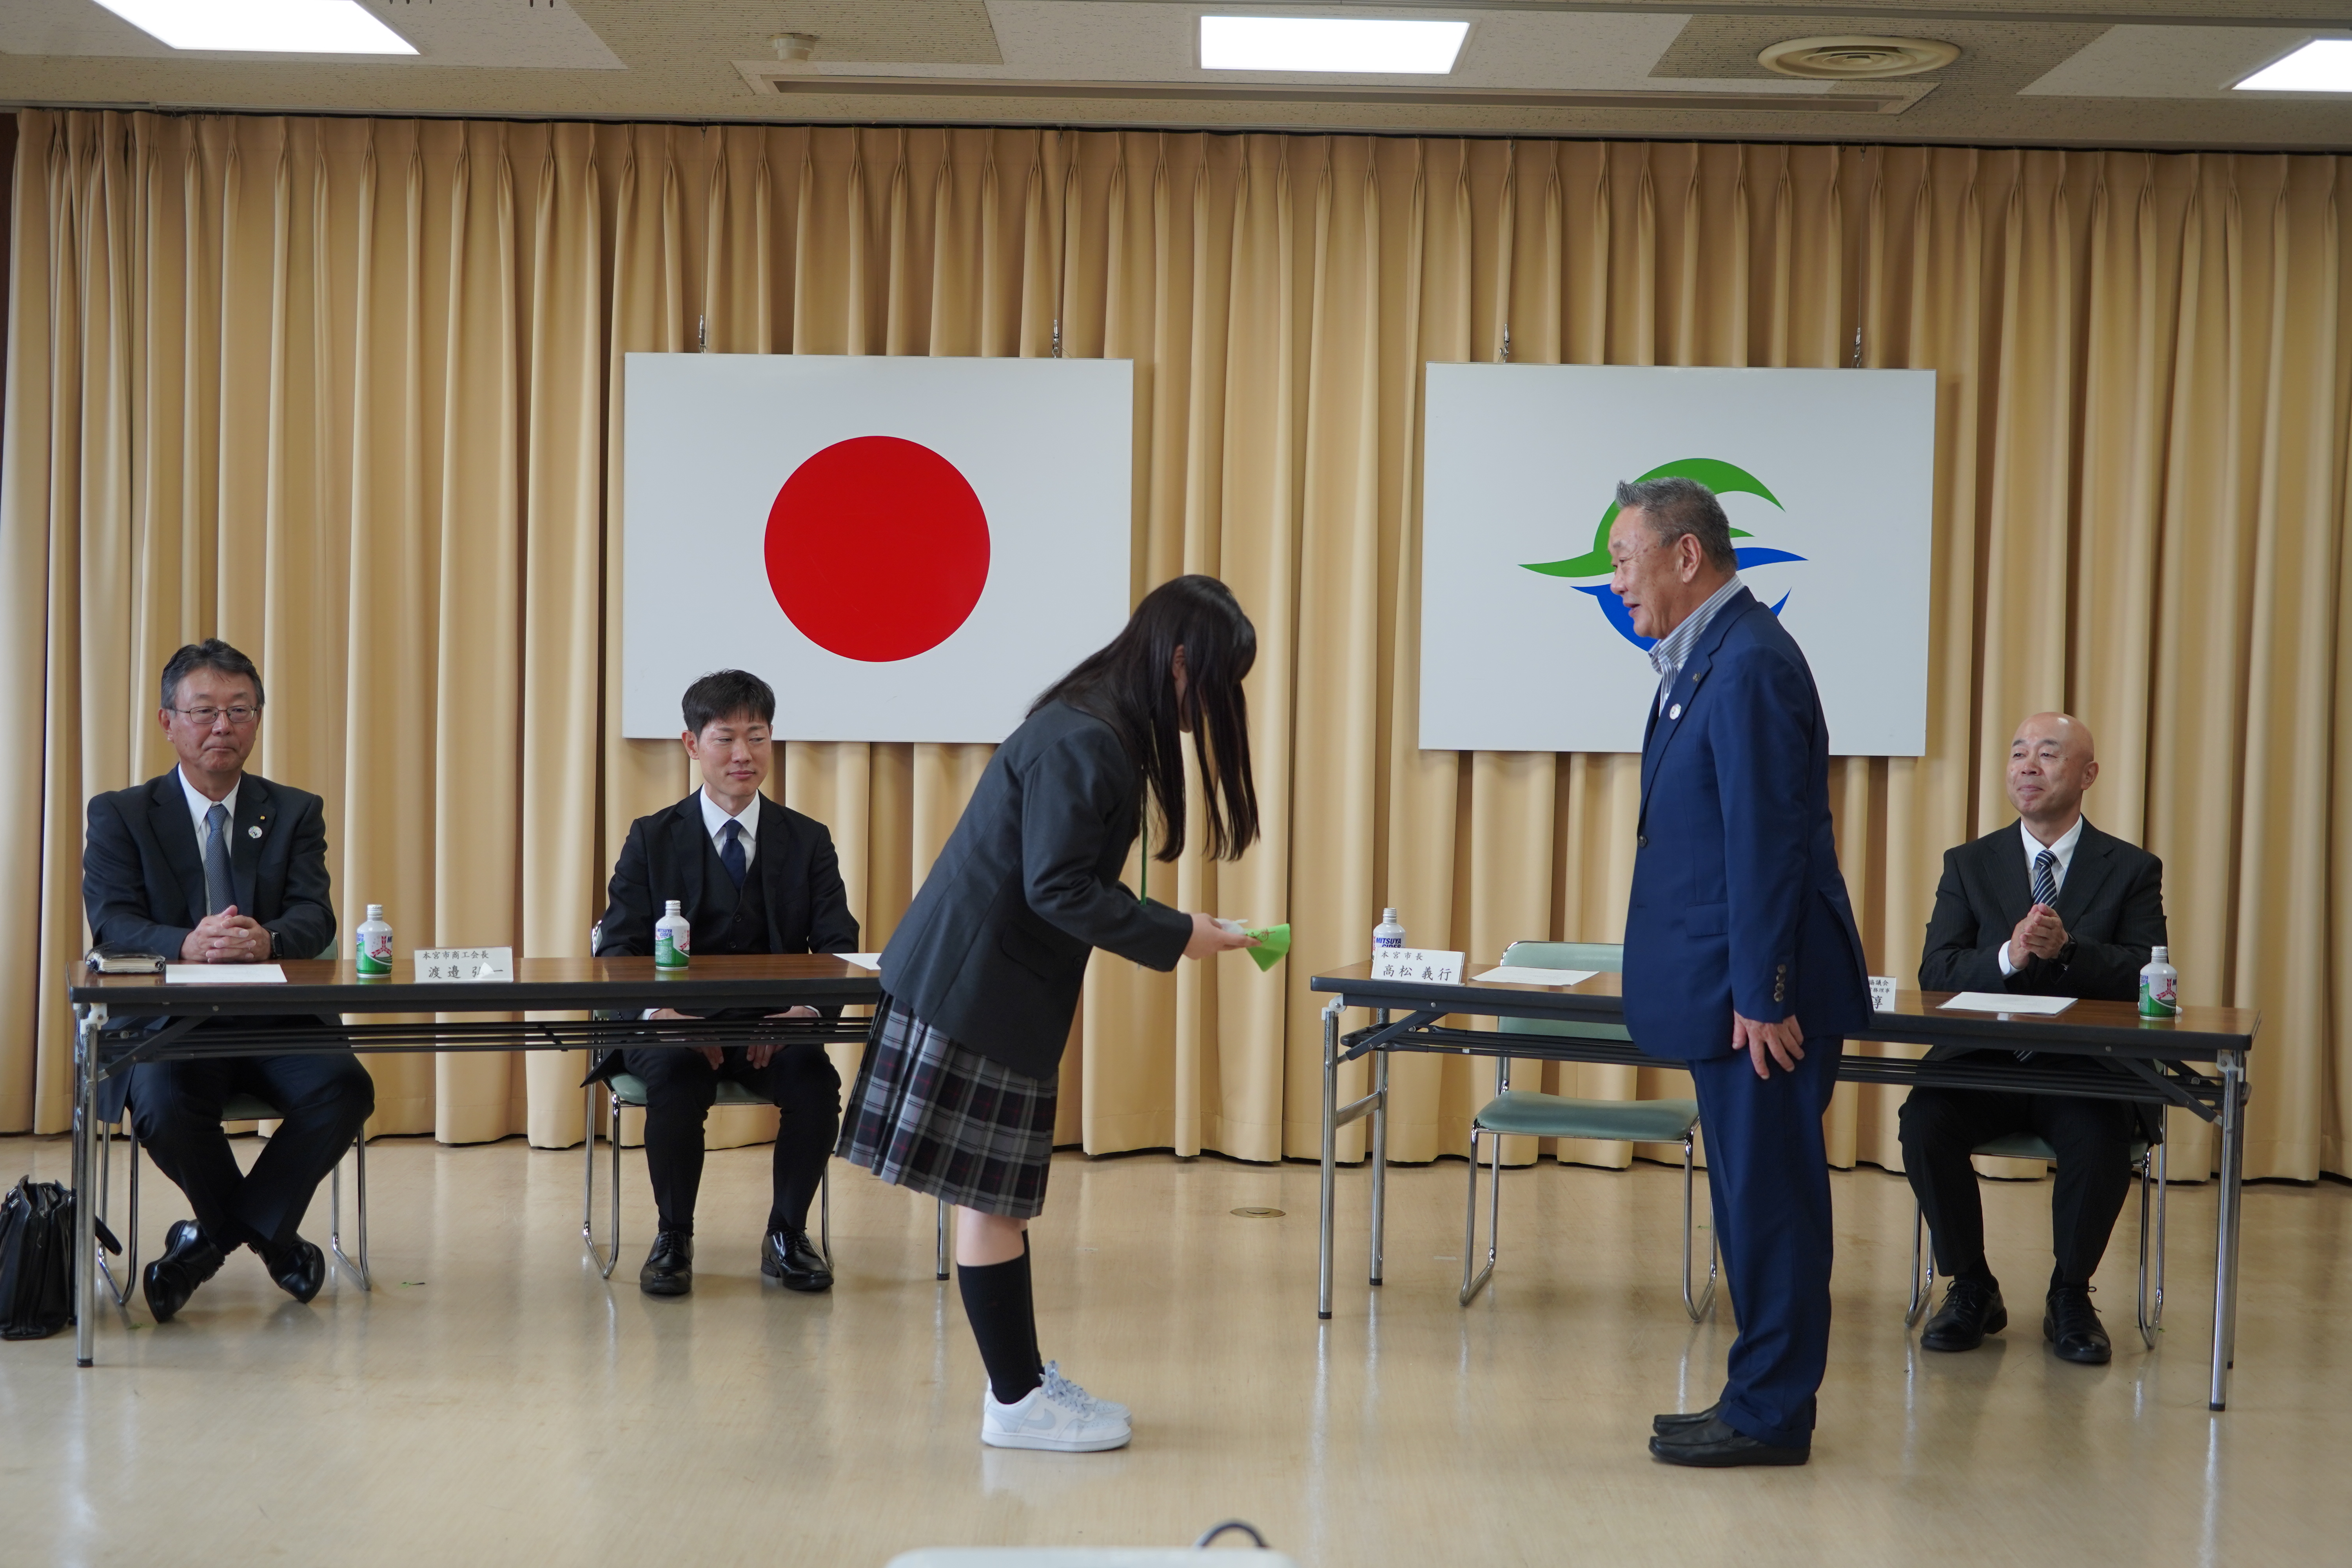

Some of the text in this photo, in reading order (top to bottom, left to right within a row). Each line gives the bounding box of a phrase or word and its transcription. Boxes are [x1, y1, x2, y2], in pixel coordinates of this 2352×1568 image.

[423, 950, 489, 960] 本宮市商工会長
[1381, 951, 1423, 960] 本宮市長
[1383, 964, 1452, 981] 高松 義行
